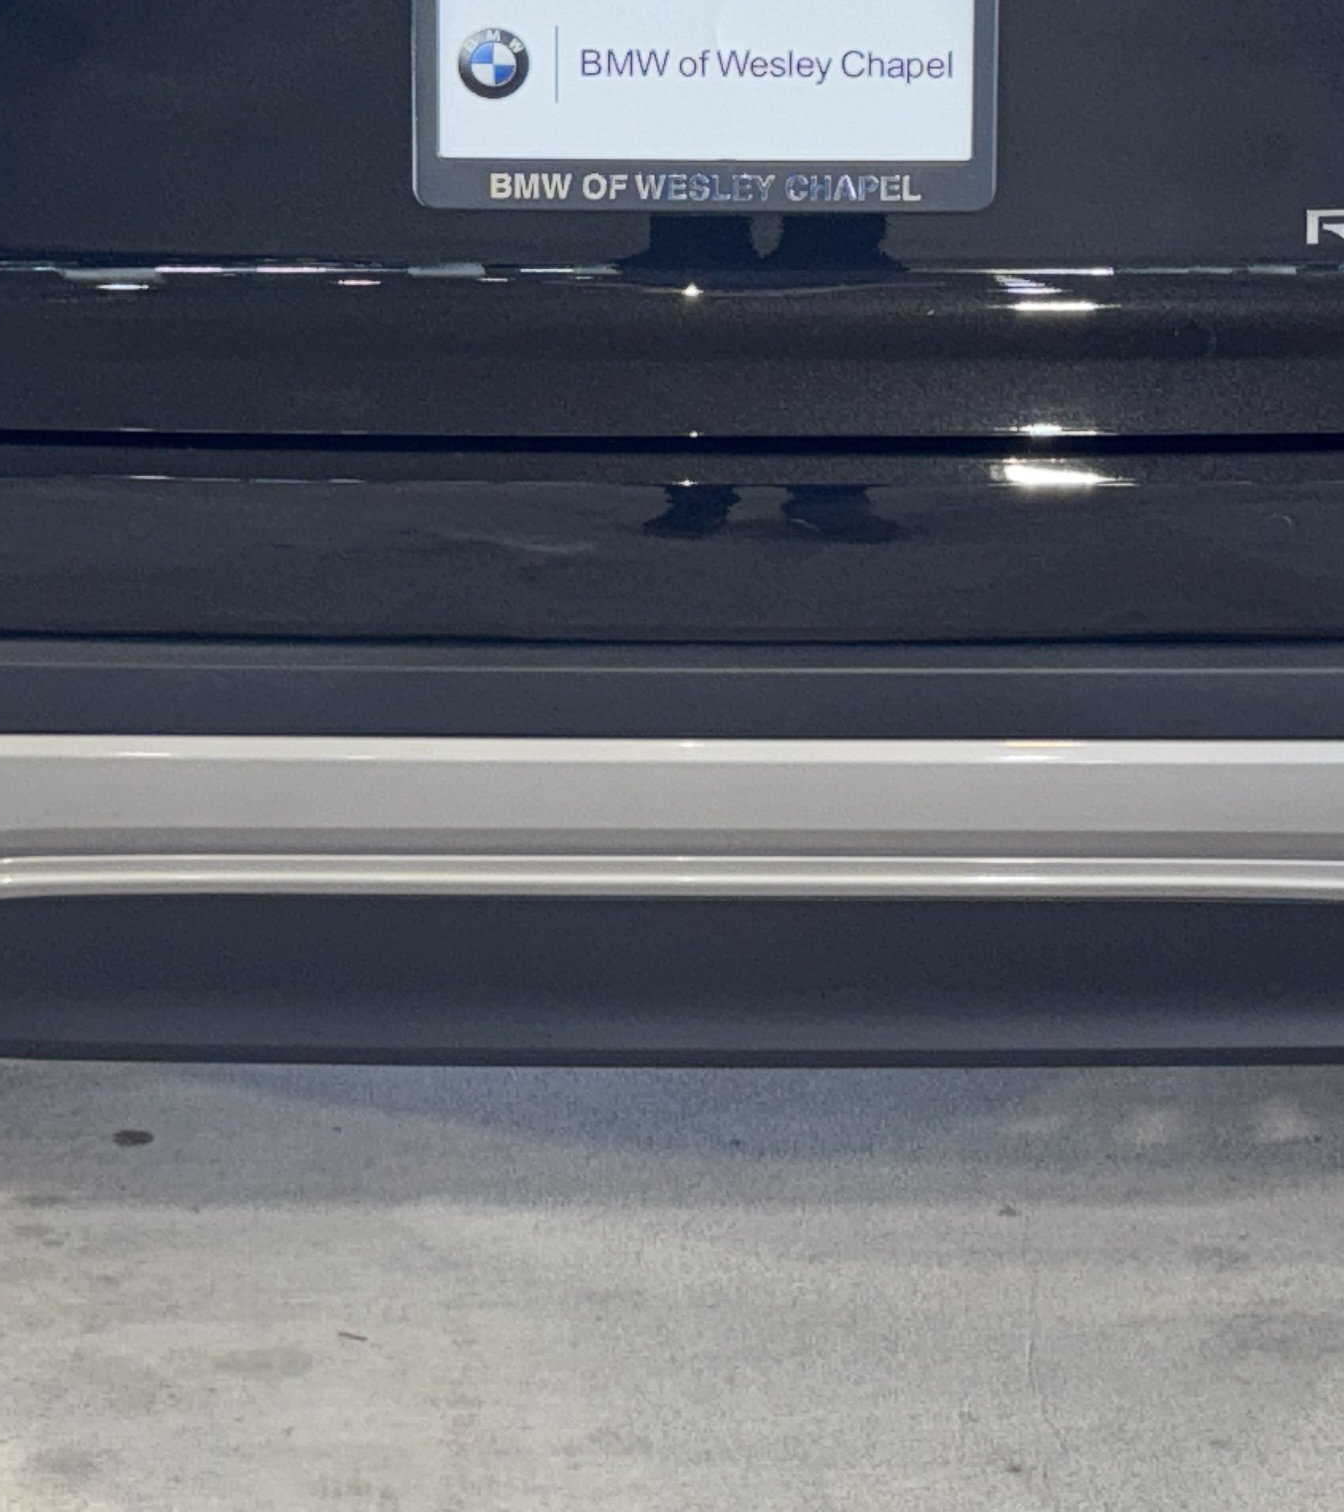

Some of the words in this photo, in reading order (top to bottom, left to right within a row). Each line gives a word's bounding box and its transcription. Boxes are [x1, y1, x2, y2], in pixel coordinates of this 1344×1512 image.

[580, 48, 670, 78] BMW
[678, 49, 711, 78] of
[716, 49, 833, 85] Wesley
[840, 49, 954, 85] Chapel
[488, 172, 572, 200] BMW
[581, 172, 628, 200] OF
[634, 172, 775, 201] WESLEY
[783, 173, 923, 201] CHAPEL
